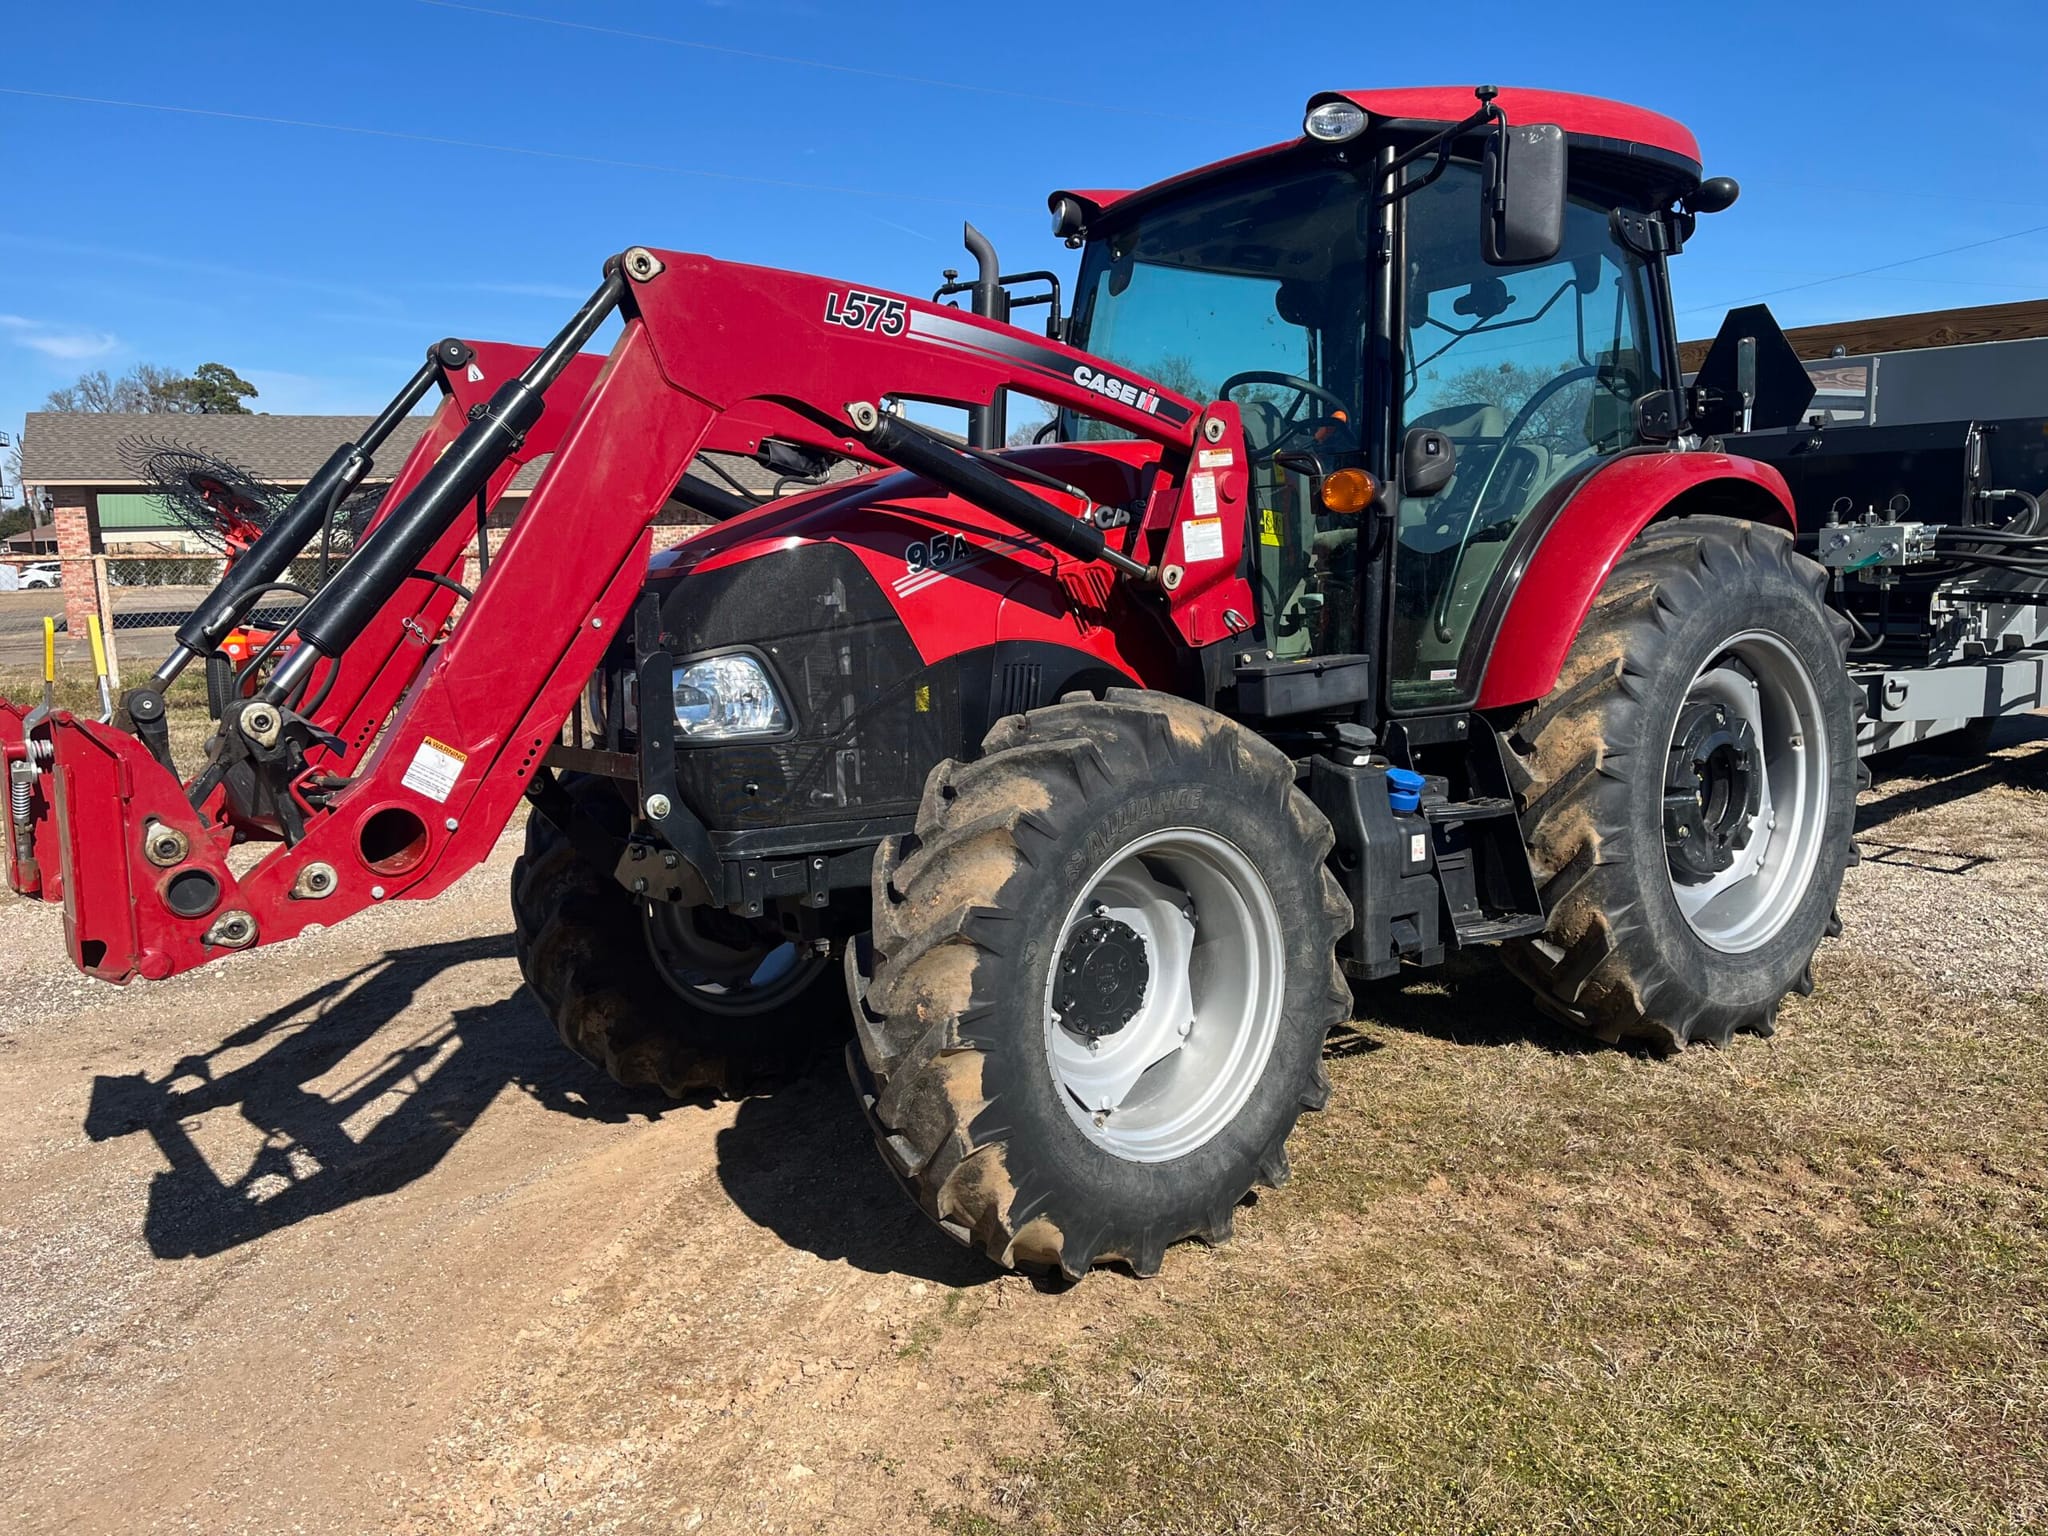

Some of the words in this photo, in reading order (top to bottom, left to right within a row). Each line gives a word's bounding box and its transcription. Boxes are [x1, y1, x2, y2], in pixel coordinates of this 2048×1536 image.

[824, 290, 907, 336] L575
[1073, 366, 1138, 405] CASE
[906, 531, 972, 575] 95A
[432, 740, 466, 762] WARNING
[1086, 788, 1202, 864] ALLIANCE
